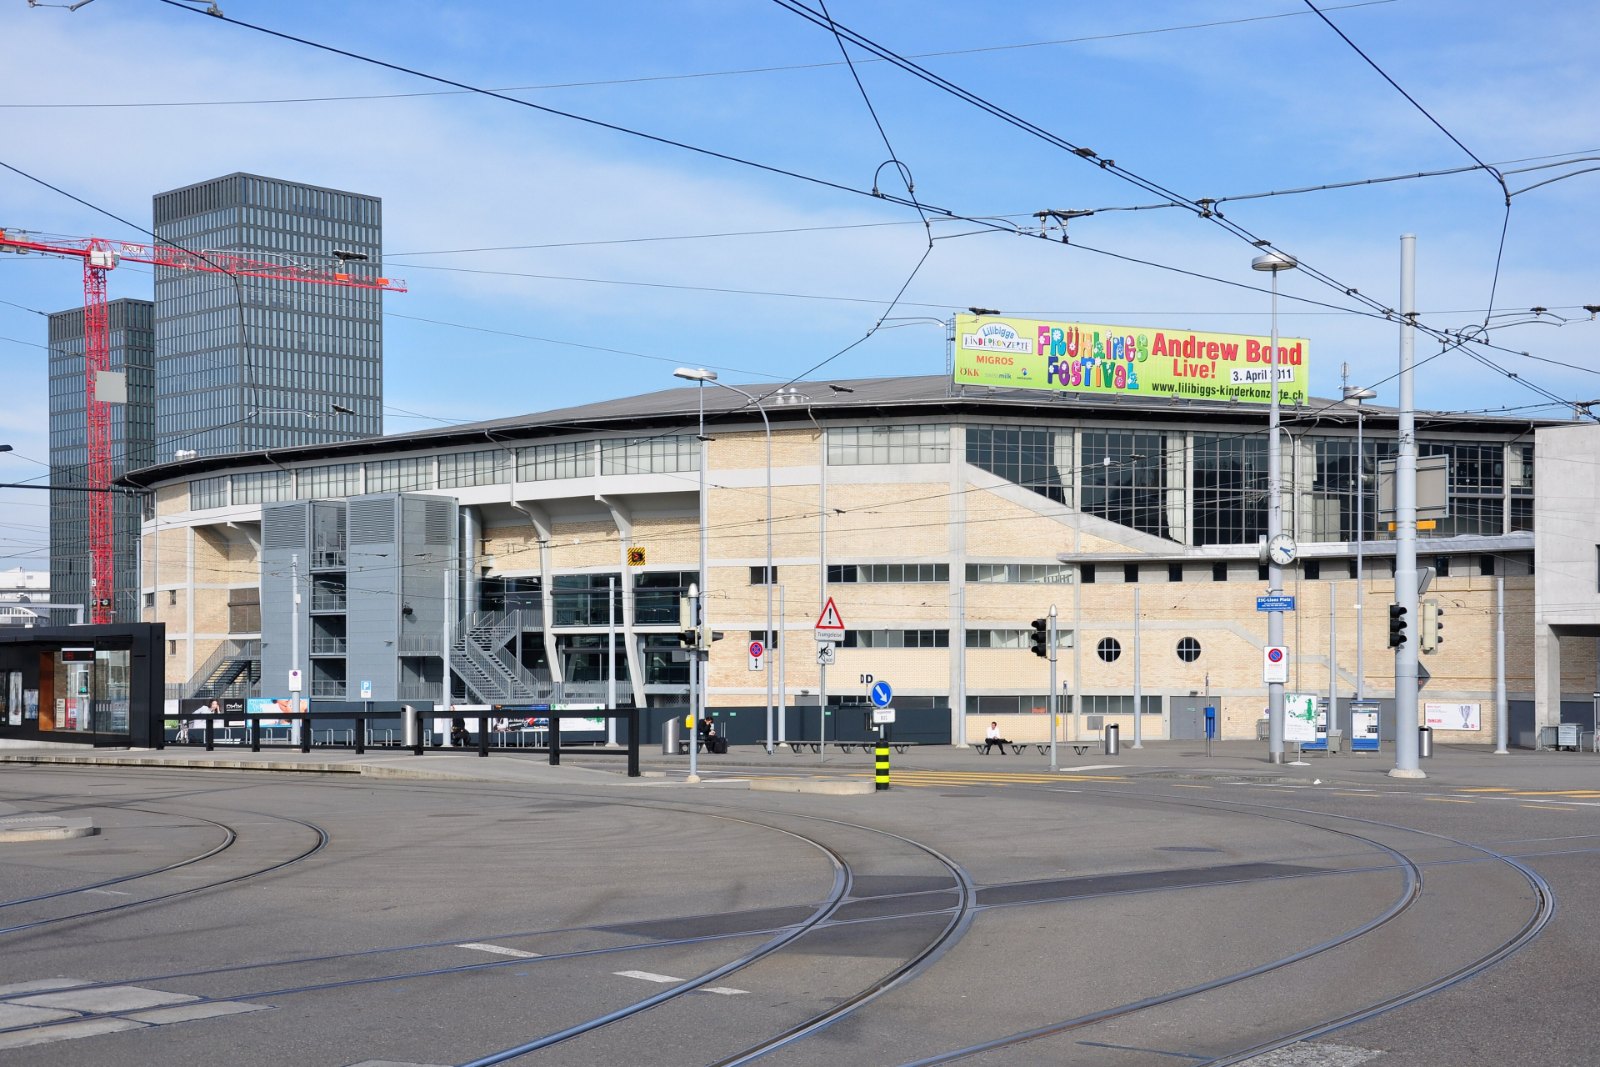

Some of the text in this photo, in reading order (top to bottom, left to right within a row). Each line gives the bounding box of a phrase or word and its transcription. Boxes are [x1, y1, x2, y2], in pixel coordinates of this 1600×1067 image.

[982, 325, 1015, 340] Lilibiggs
[1152, 333, 1302, 366] Andrew Bond
[976, 355, 1014, 366] MIGROS
[1173, 358, 1216, 379] Live!
[1233, 369, 1291, 382] 3. April 011
[1152, 382, 1304, 400] www.lilibiggs-kinderkonzte.ch
